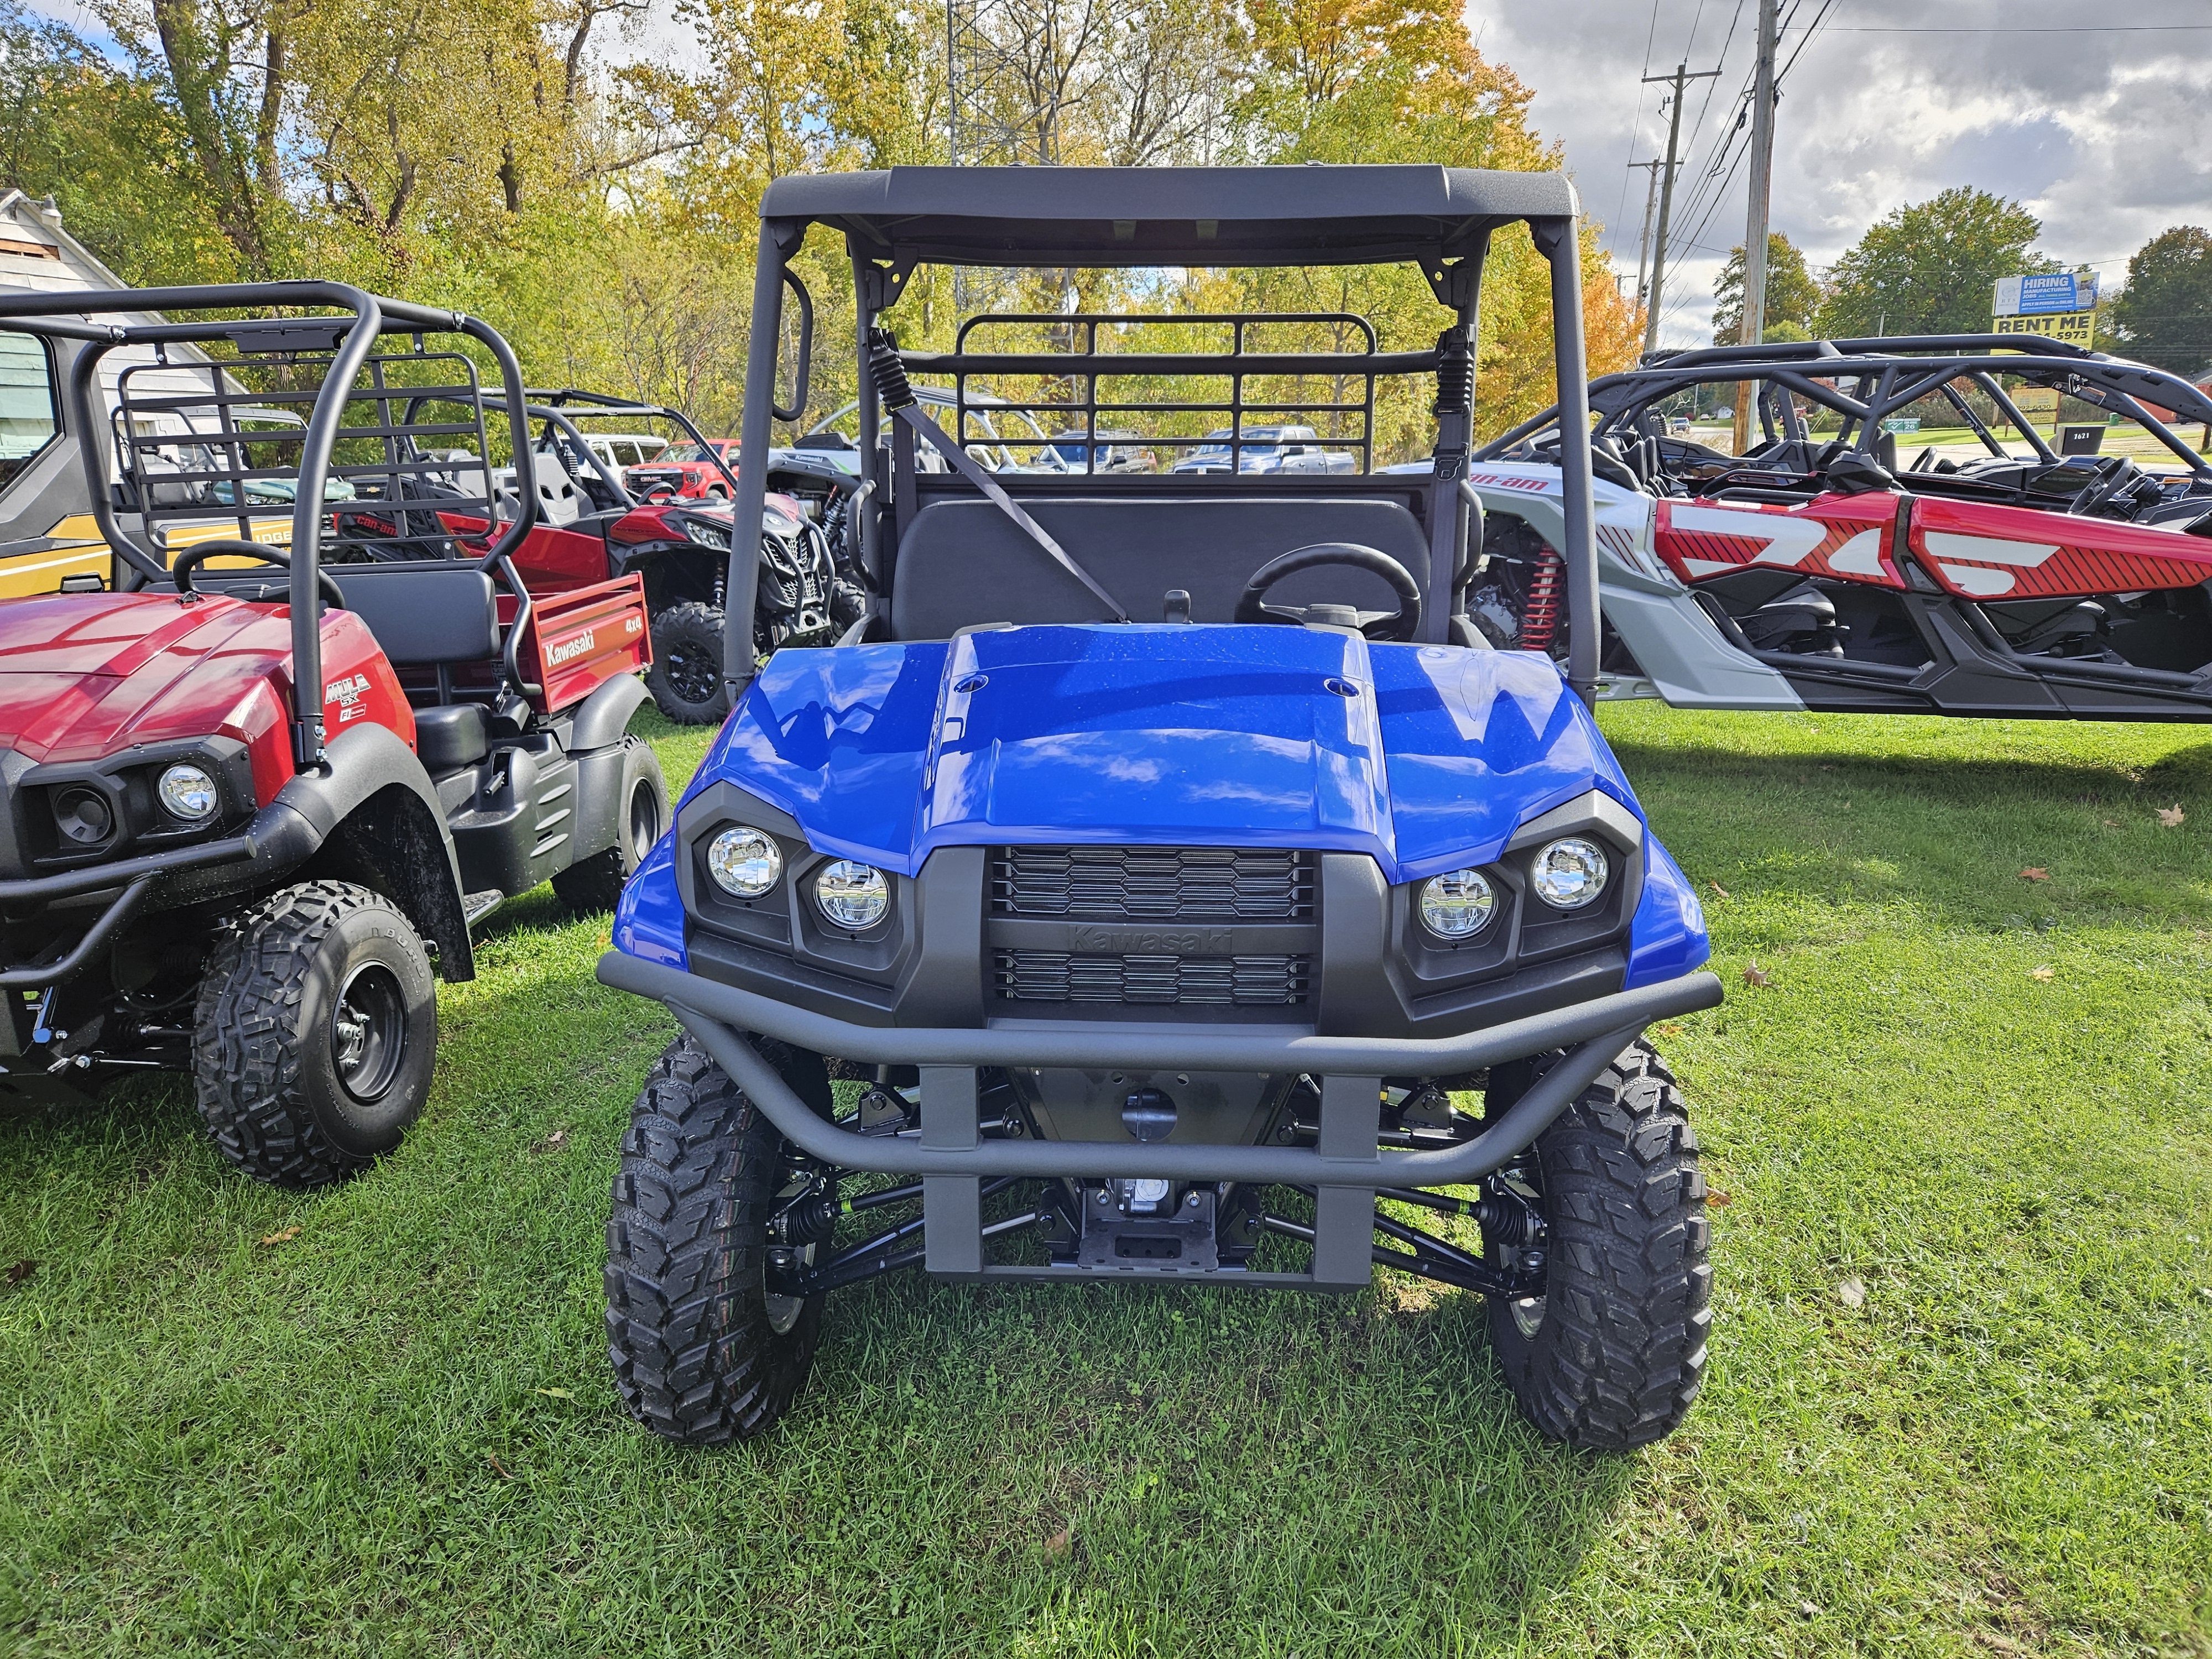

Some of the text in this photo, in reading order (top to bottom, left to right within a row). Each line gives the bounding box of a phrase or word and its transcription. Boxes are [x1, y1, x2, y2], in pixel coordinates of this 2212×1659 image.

[2024, 276, 2069, 289] HIRING
[1998, 316, 2090, 333] RENT ME
[795, 455, 823, 463] Kawasaki
[1470, 473, 1548, 491] an-am
[357, 515, 398, 537] can-am
[255, 531, 292, 544] IDGE
[625, 615, 643, 633] 4x4
[545, 629, 594, 667] Kawasaki
[325, 673, 372, 705] MULE
[341, 694, 359, 707] SX
[1068, 925, 1233, 953] Kawasaki
[384, 927, 426, 978] DURO
